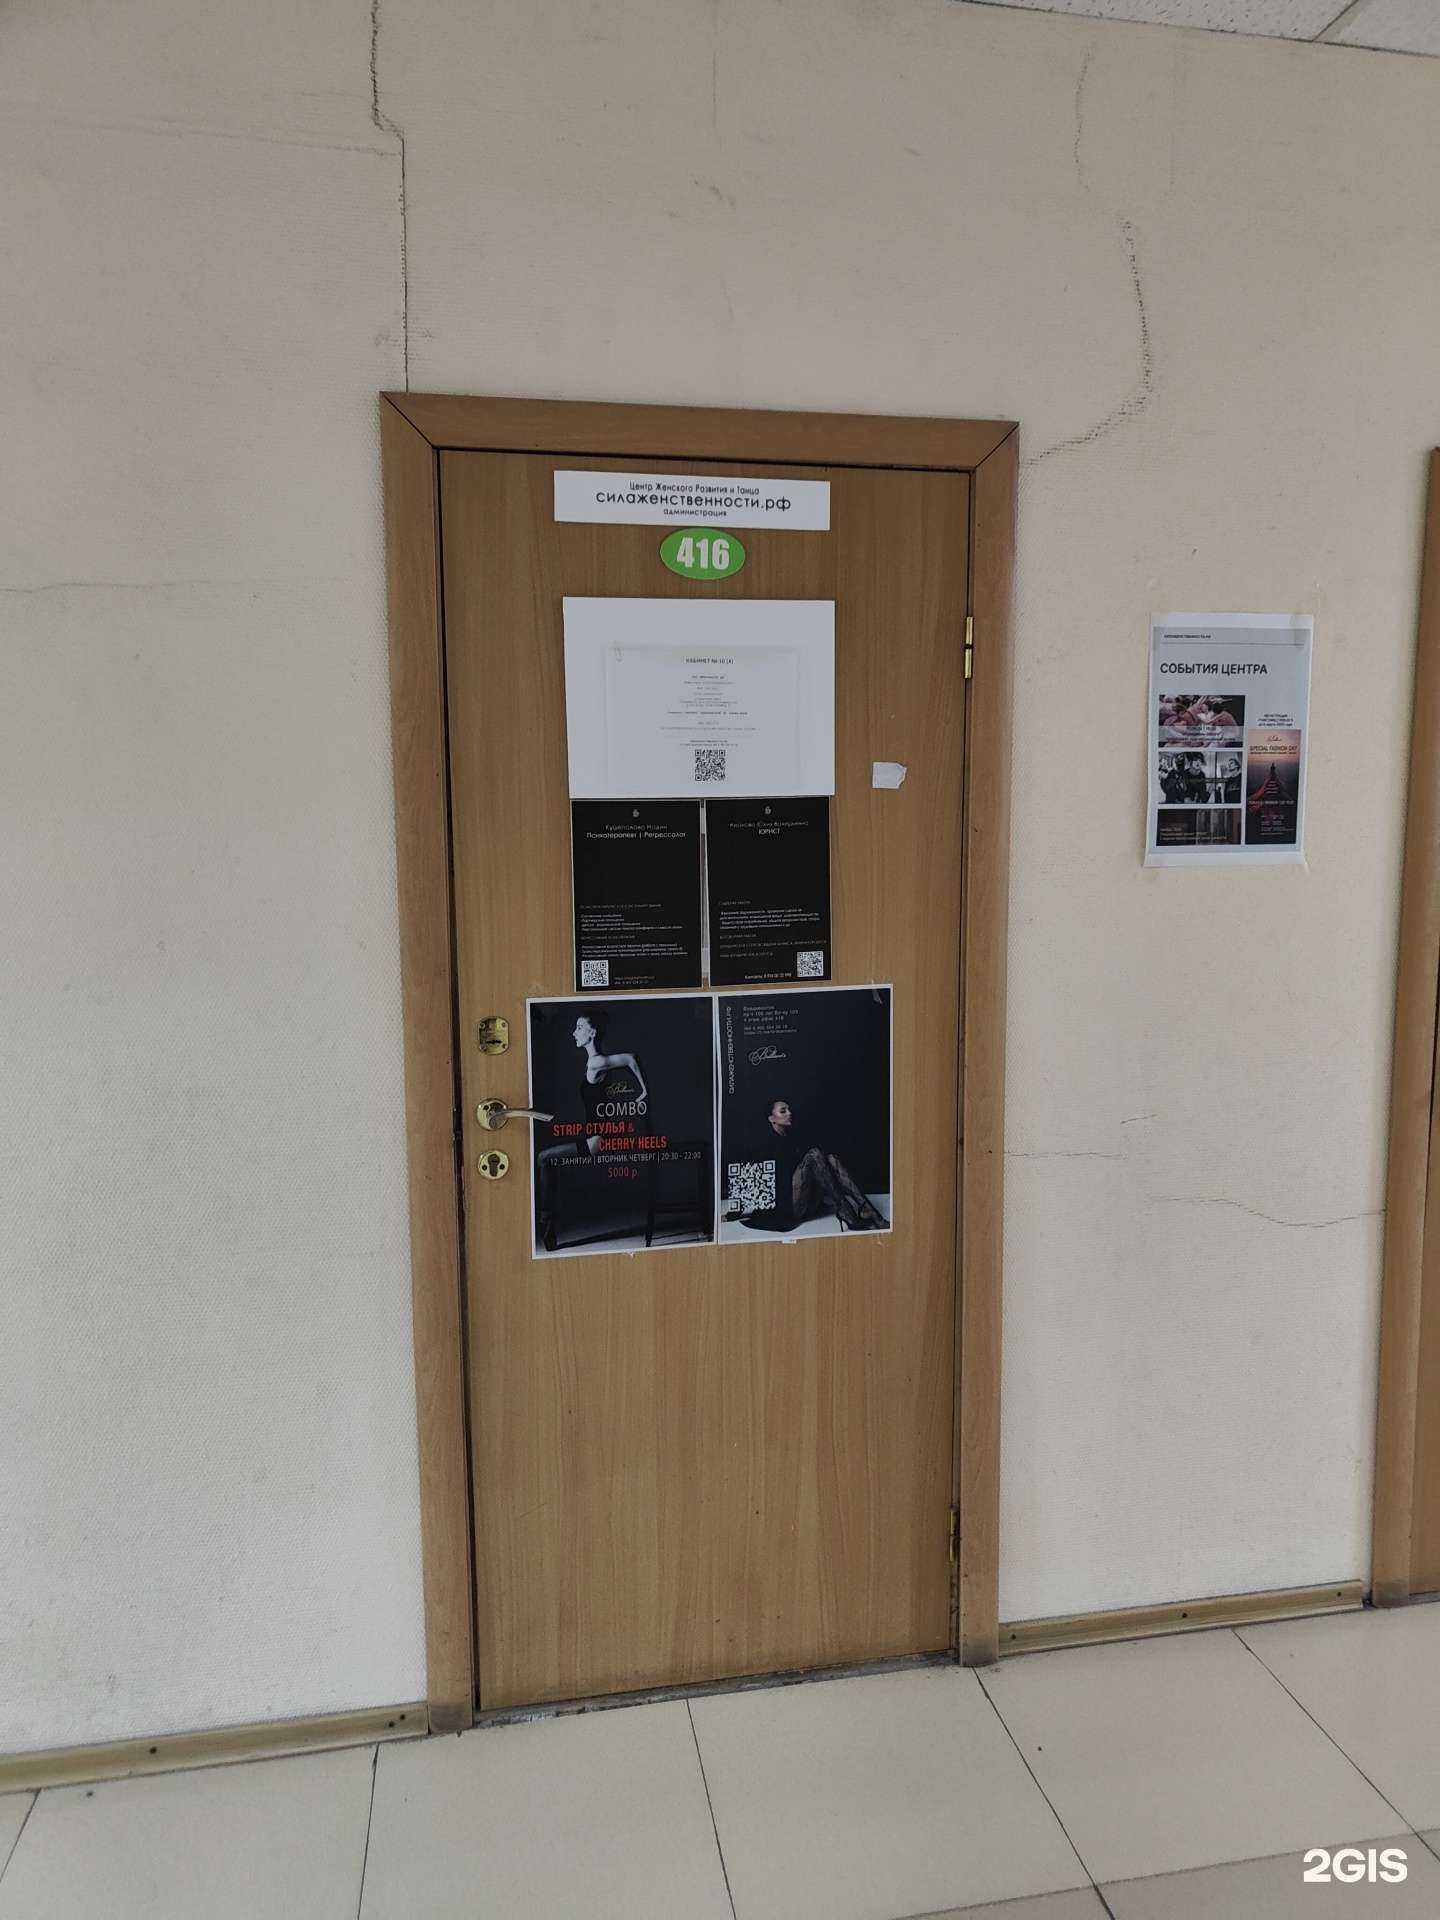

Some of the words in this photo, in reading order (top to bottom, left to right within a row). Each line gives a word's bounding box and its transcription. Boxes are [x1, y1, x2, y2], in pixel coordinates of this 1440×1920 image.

[629, 482, 653, 492] Центр
[655, 482, 693, 494] Женского
[695, 484, 728, 495] Развития
[736, 485, 760, 496] Танца
[595, 491, 792, 512] силаженственности.рф
[663, 508, 727, 518] администрация
[676, 536, 730, 570] 416
[1159, 663, 1218, 675] СОБЫТИЯ
[1221, 663, 1268, 677] ЦЕНТРА
[596, 1101, 647, 1118] COMBO
[553, 1123, 583, 1137] STRIP
[586, 1121, 625, 1135] СТУЛЬЯ
[599, 1136, 636, 1151] CHERRY
[638, 1135, 668, 1149] HEELS
[597, 1155, 629, 1164] ВТОРНИК
[629, 1153, 656, 1162] ЧЕТВЕРГ
[607, 1167, 629, 1178] 5000
